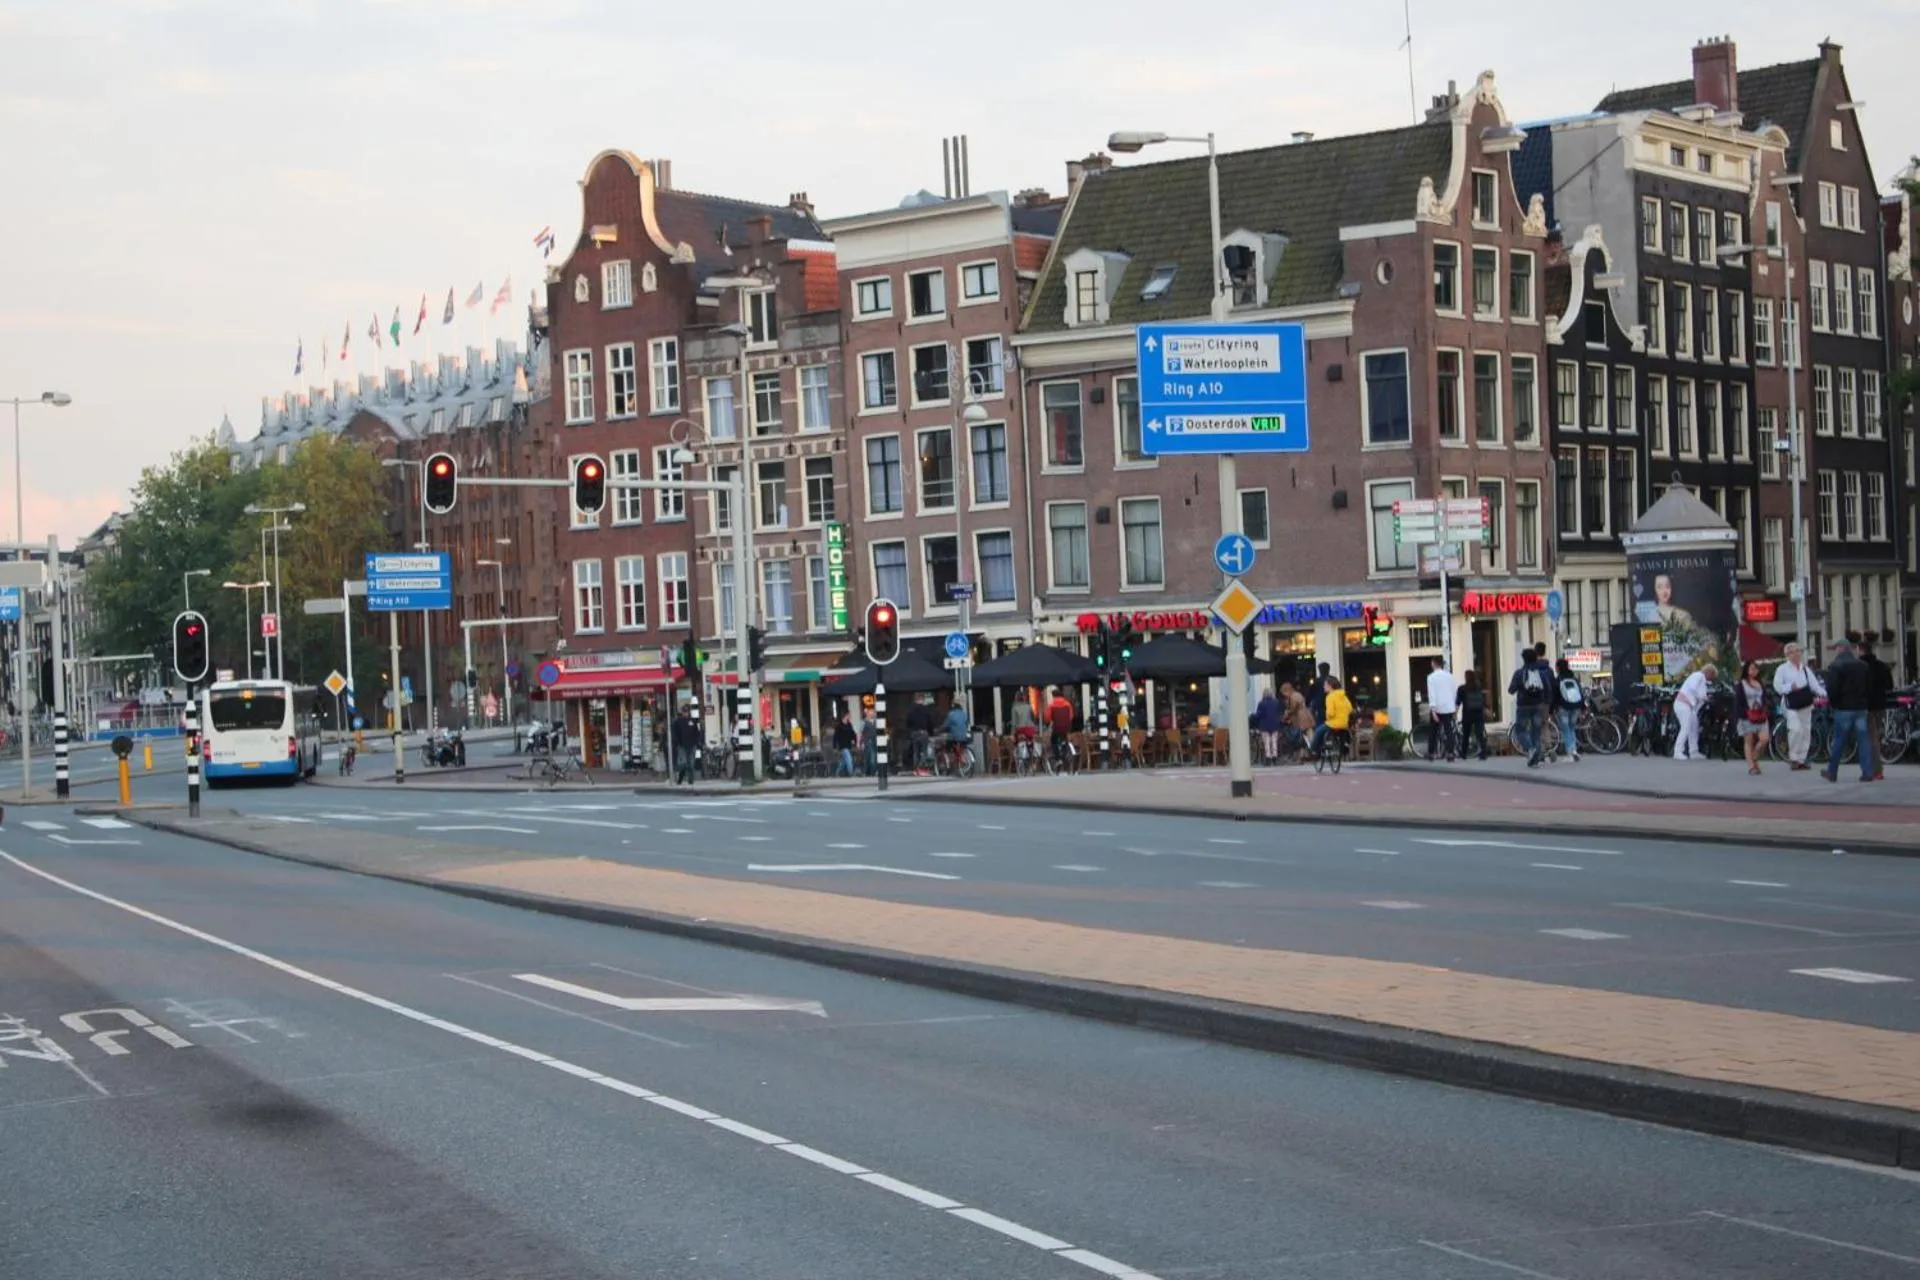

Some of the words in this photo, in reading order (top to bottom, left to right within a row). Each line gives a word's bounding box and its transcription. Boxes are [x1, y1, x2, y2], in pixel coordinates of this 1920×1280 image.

[1207, 339, 1259, 351] Cityring
[1184, 358, 1268, 370] Waterlooplein
[1164, 382, 1193, 398] Ring
[1198, 381, 1223, 395] A10
[1186, 417, 1248, 430] Oosterdok
[827, 526, 847, 630] HOTEL
